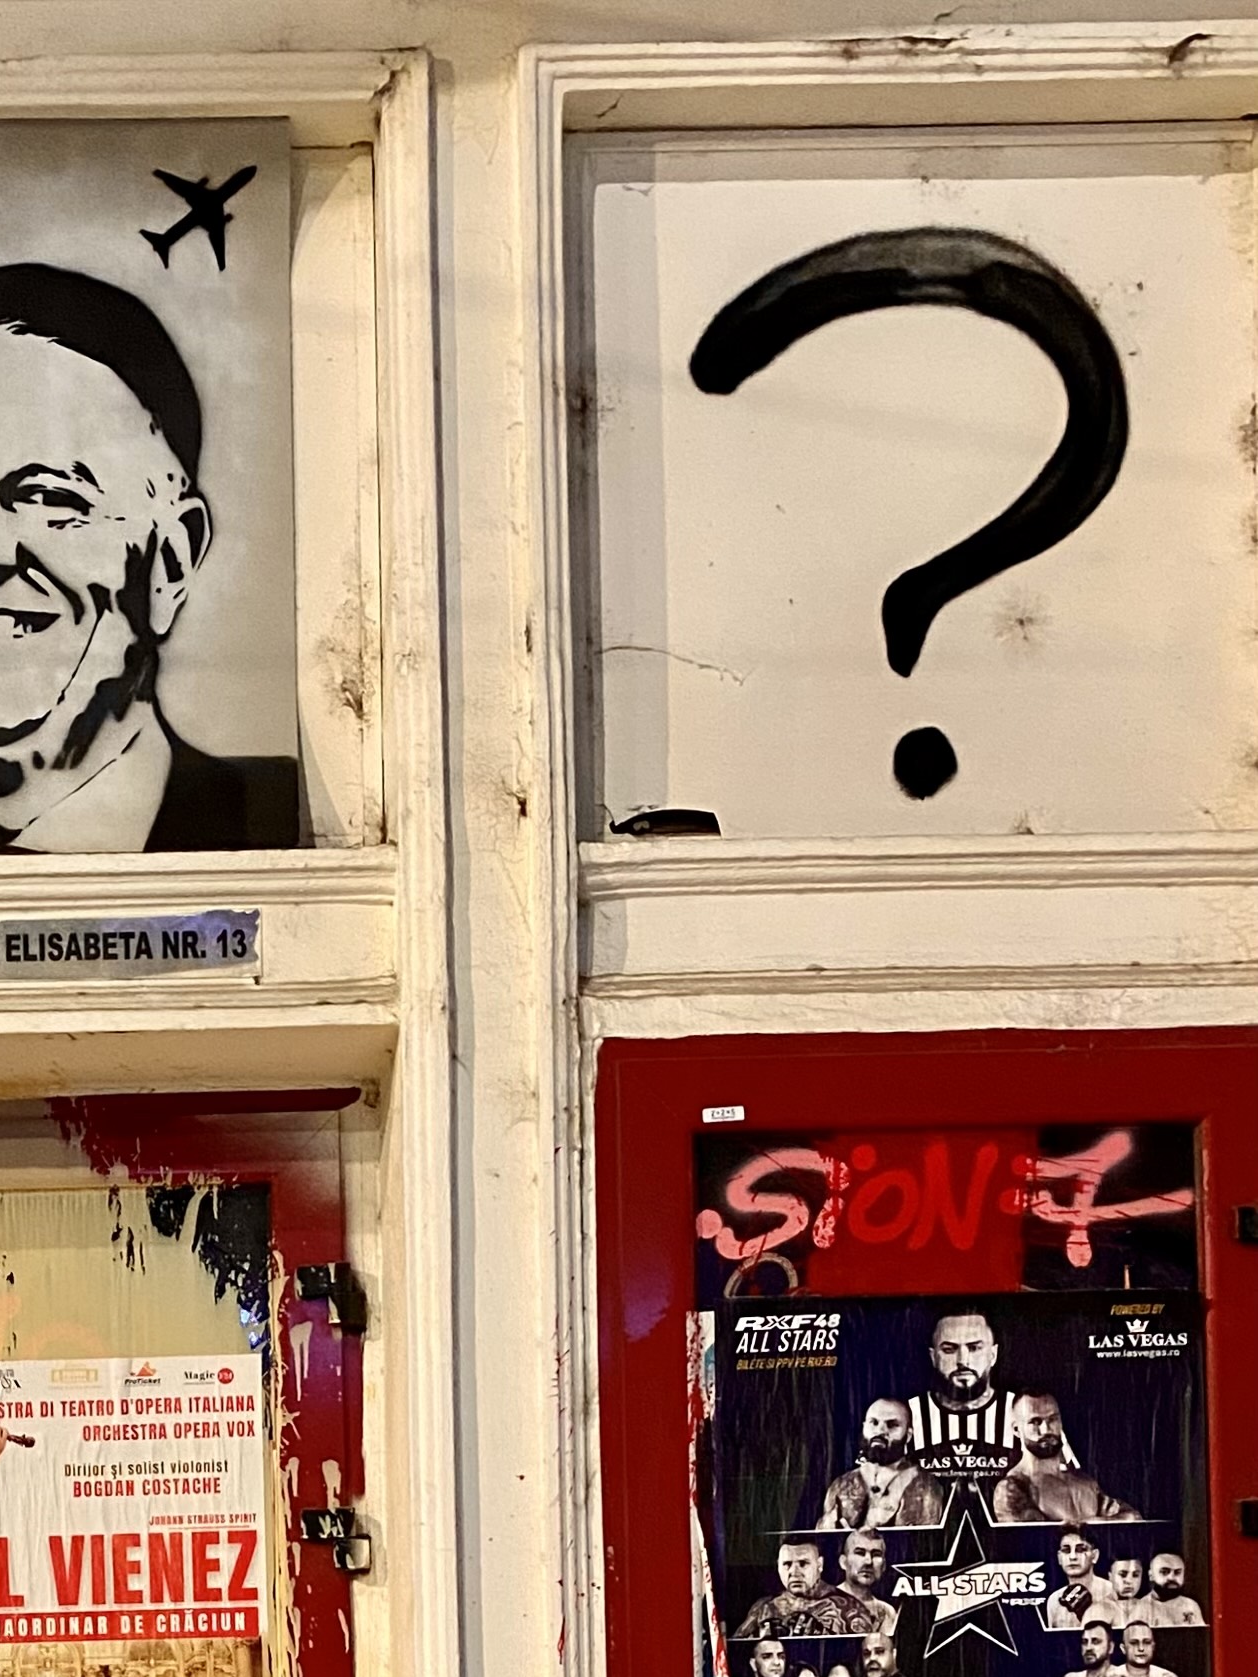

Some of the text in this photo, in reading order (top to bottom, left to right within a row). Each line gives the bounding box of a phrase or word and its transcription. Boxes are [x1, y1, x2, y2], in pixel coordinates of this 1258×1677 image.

[688, 226, 1130, 802] ?
[5, 931, 154, 963] ELISABETA
[161, 930, 207, 960] NR.
[216, 929, 248, 958] 13
[814, 1313, 841, 1328] 48
[735, 1329, 840, 1354] ALL STARS
[1088, 1332, 1188, 1349] LAS VEGAS
[40, 1400, 55, 1418] DI
[61, 1399, 115, 1418] TEATRO
[120, 1397, 183, 1416] D'OPERA
[188, 1395, 256, 1414] ITALIANA
[83, 1420, 256, 1442] ORCHESTRA OPERA VOX
[919, 1456, 1008, 1469] LAS VEGAS
[73, 1477, 222, 1498] BOGDAN COSTACHE
[48, 1529, 259, 1608] VIENEZ
[891, 1572, 1047, 1597] ALL STARS
[120, 1613, 145, 1635] DE
[156, 1607, 247, 1635] CRĂCIUN
